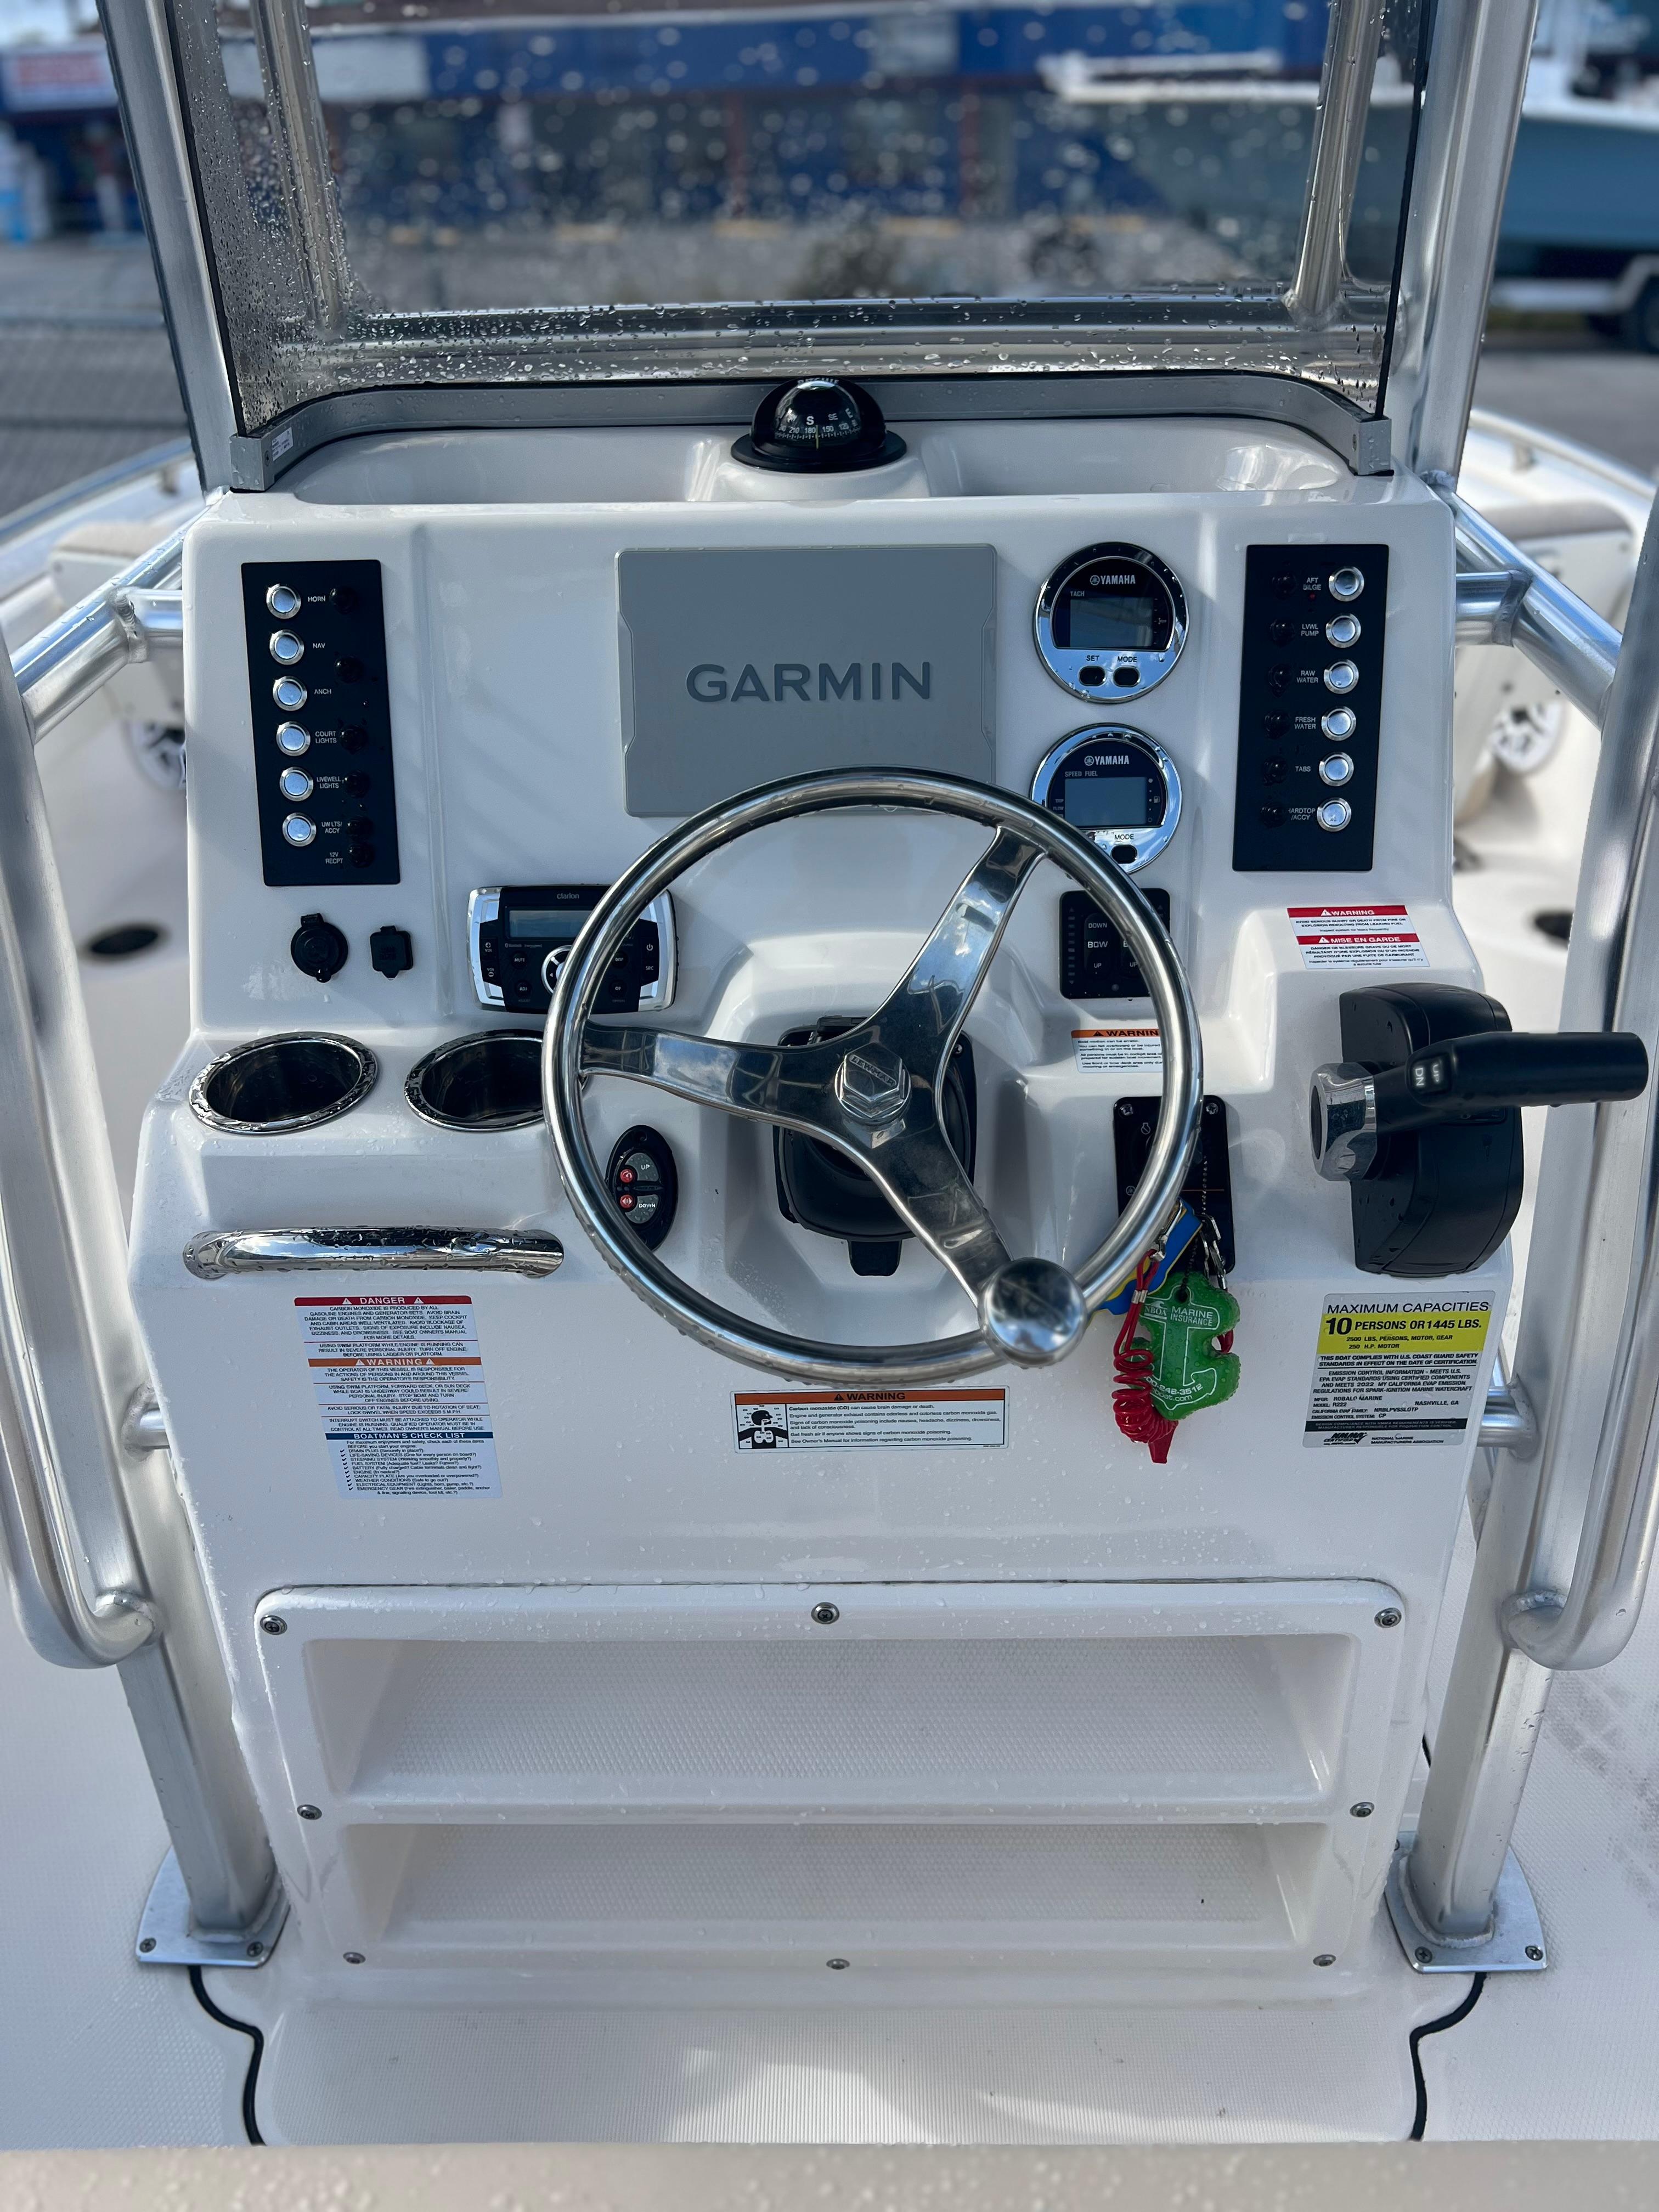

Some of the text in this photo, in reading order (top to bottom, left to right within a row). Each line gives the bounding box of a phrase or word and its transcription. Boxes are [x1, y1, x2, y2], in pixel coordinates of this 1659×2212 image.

[806, 416, 815, 425] S
[845, 408, 853, 418] E
[1101, 574, 1136, 584] YAMAHA
[686, 662, 930, 702] GARMIN
[1094, 755, 1130, 765] YAMAHA
[851, 1056, 895, 1087] LEWMAR
[1415, 1068, 1424, 1086] DN
[1433, 1064, 1439, 1082] UP
[1144, 1306, 1167, 1316] NBOA
[1171, 1306, 1213, 1319] MARINE
[1327, 1302, 1489, 1313] MAXIMUM CAPACITIES
[1170, 1314, 1212, 1327] INSURANCE
[1325, 1317, 1482, 1335] 10 PERSONS OR 1445 LBS.
[1145, 1376, 1203, 1395] 00-248-3512
